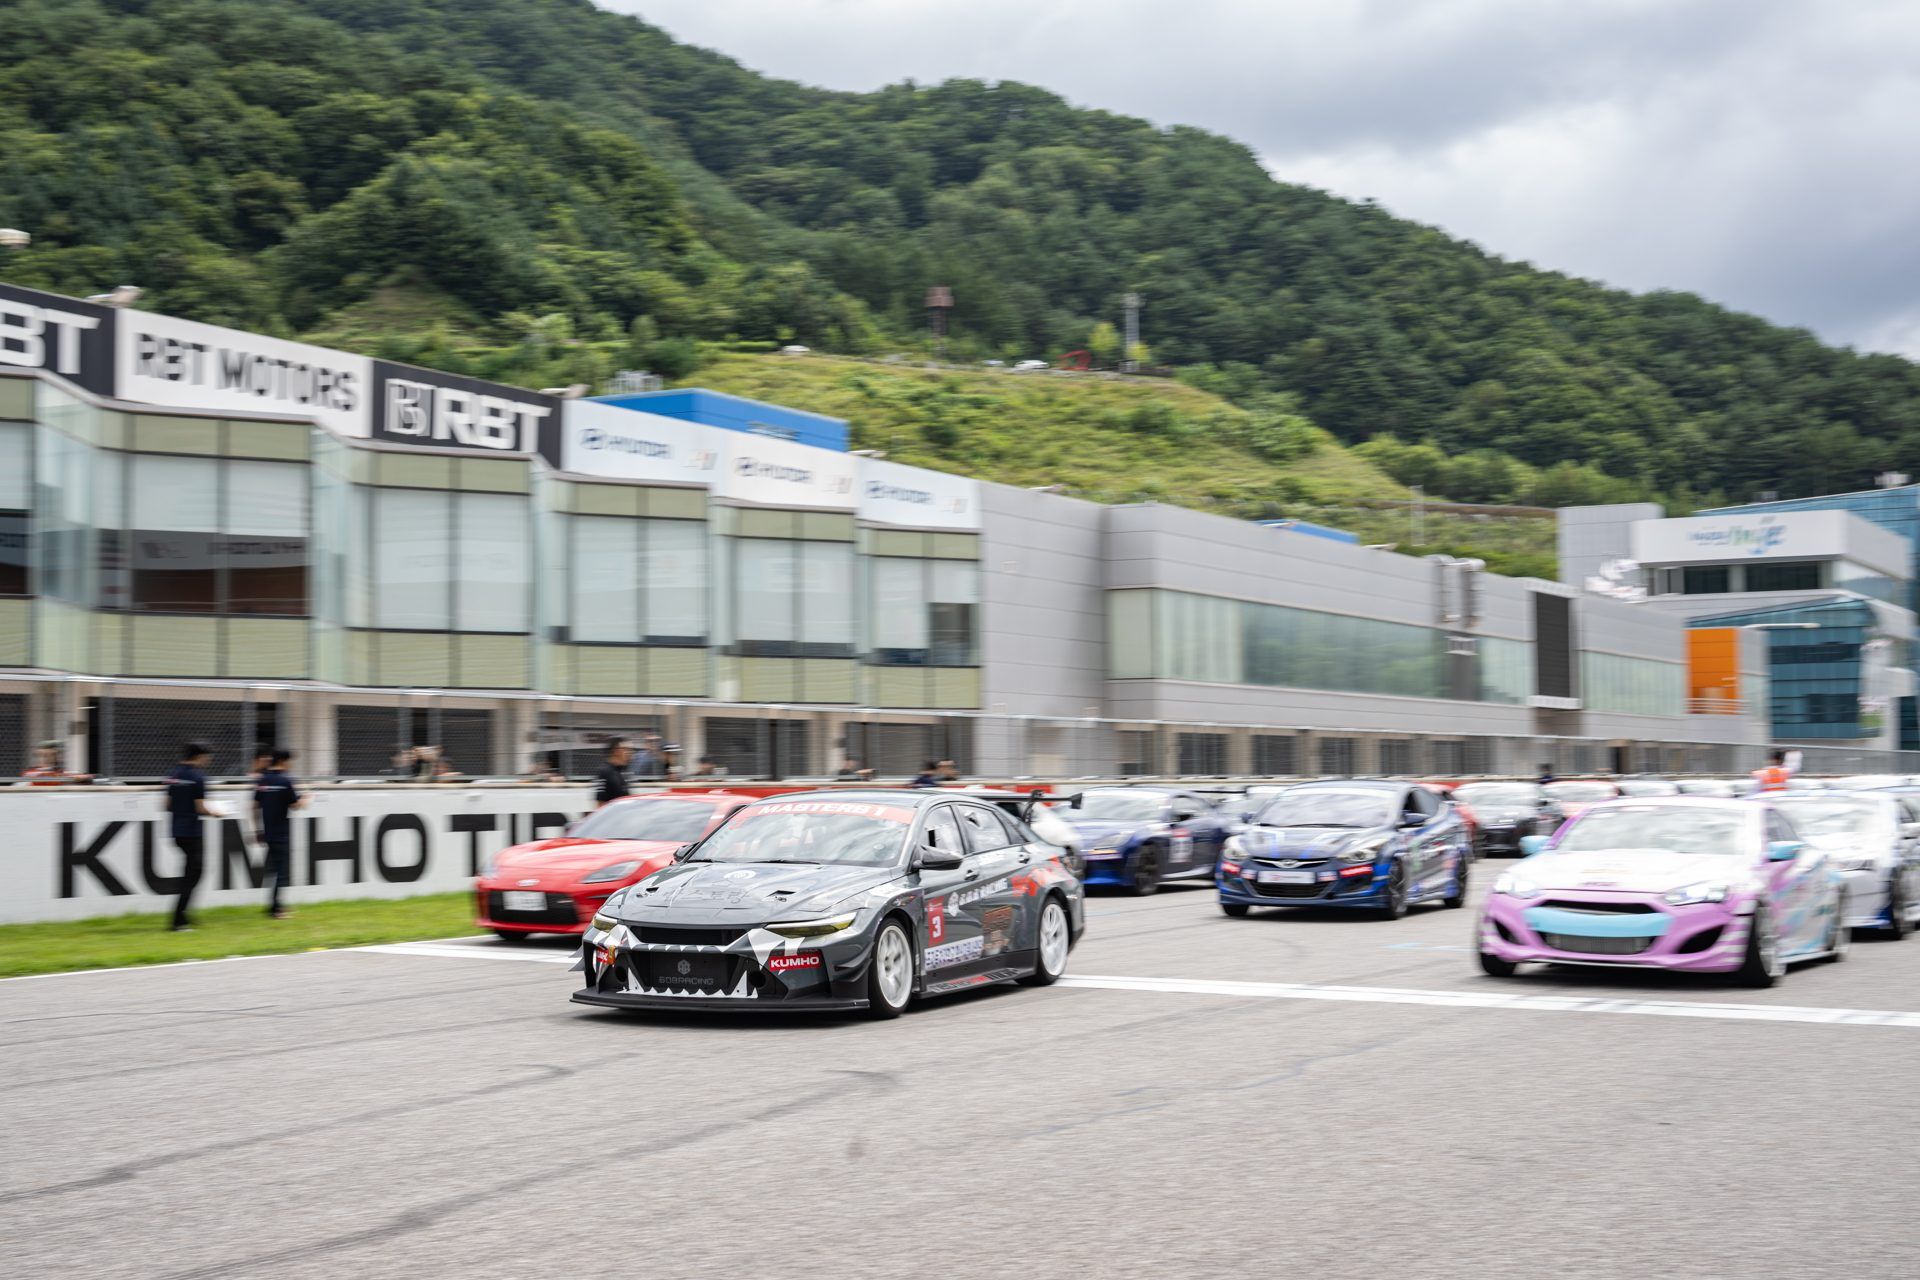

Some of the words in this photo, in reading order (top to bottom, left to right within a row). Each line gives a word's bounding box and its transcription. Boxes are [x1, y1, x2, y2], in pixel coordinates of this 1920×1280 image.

[134, 332, 209, 386] RBT
[431, 387, 553, 453] RBT
[56, 813, 430, 899] KUMHO
[931, 915, 942, 938] 3
[770, 956, 820, 968] KUMHO
